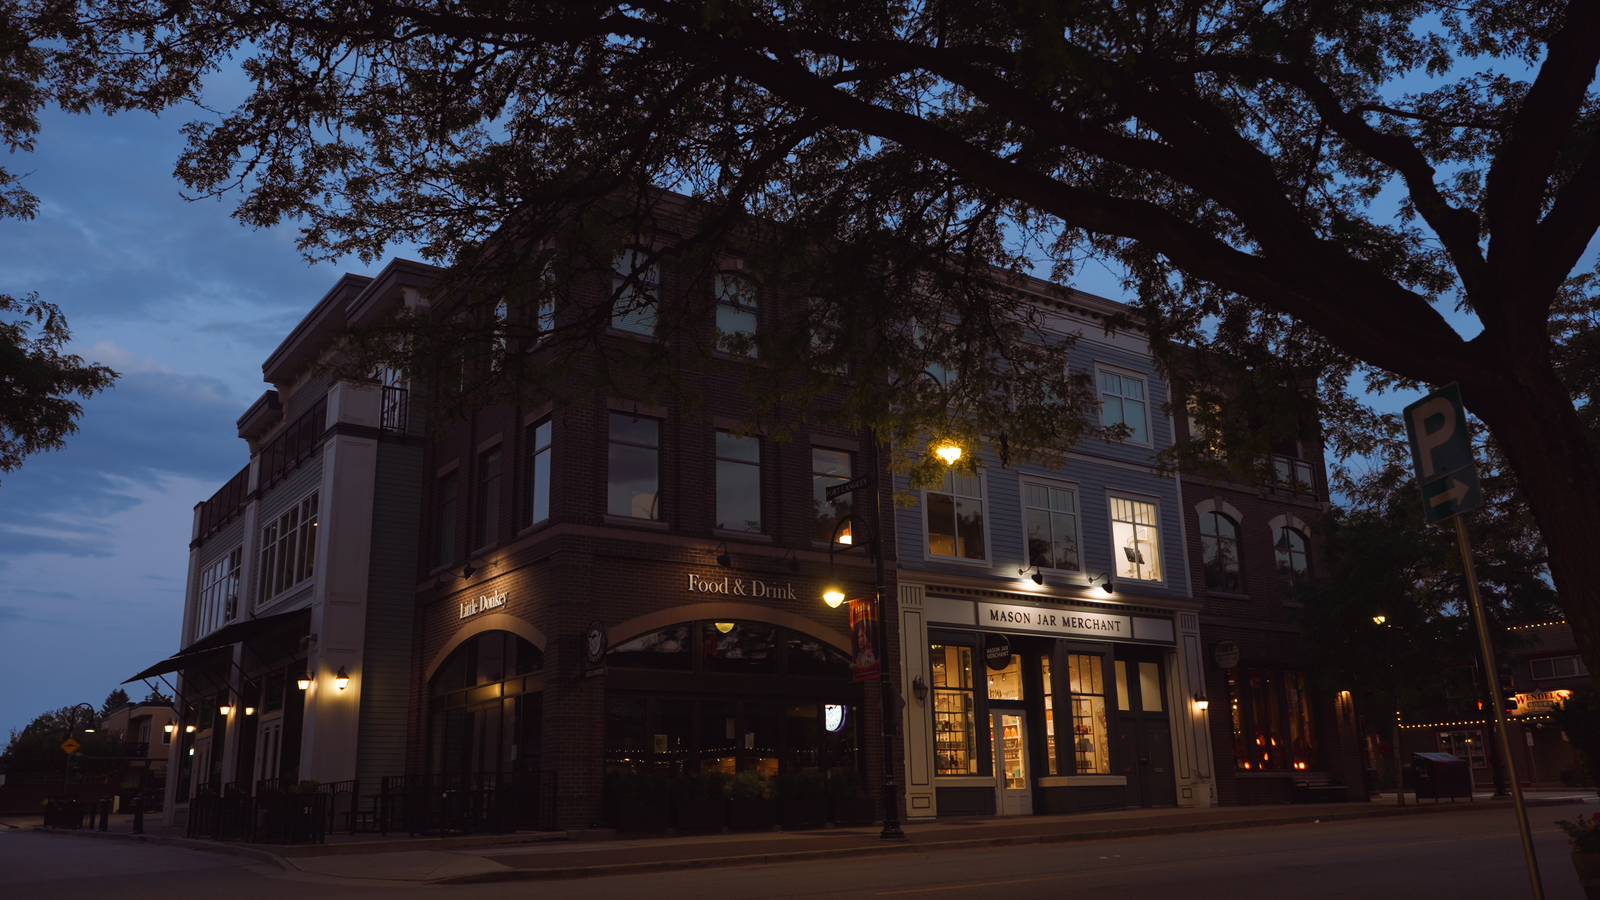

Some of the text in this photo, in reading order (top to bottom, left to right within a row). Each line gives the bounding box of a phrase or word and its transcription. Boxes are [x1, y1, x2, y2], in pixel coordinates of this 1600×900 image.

[1411, 396, 1457, 479] P
[826, 477, 868, 498] FORT LANGLEY
[688, 573, 797, 600] Food & Drink
[460, 590, 509, 619] Little Donkey
[990, 609, 1121, 632] MASON JAR MERCHANT
[986, 646, 1001, 654] MASON
[986, 650, 1009, 659] MERCHANT
[1515, 691, 1563, 704] WENDEL'S
